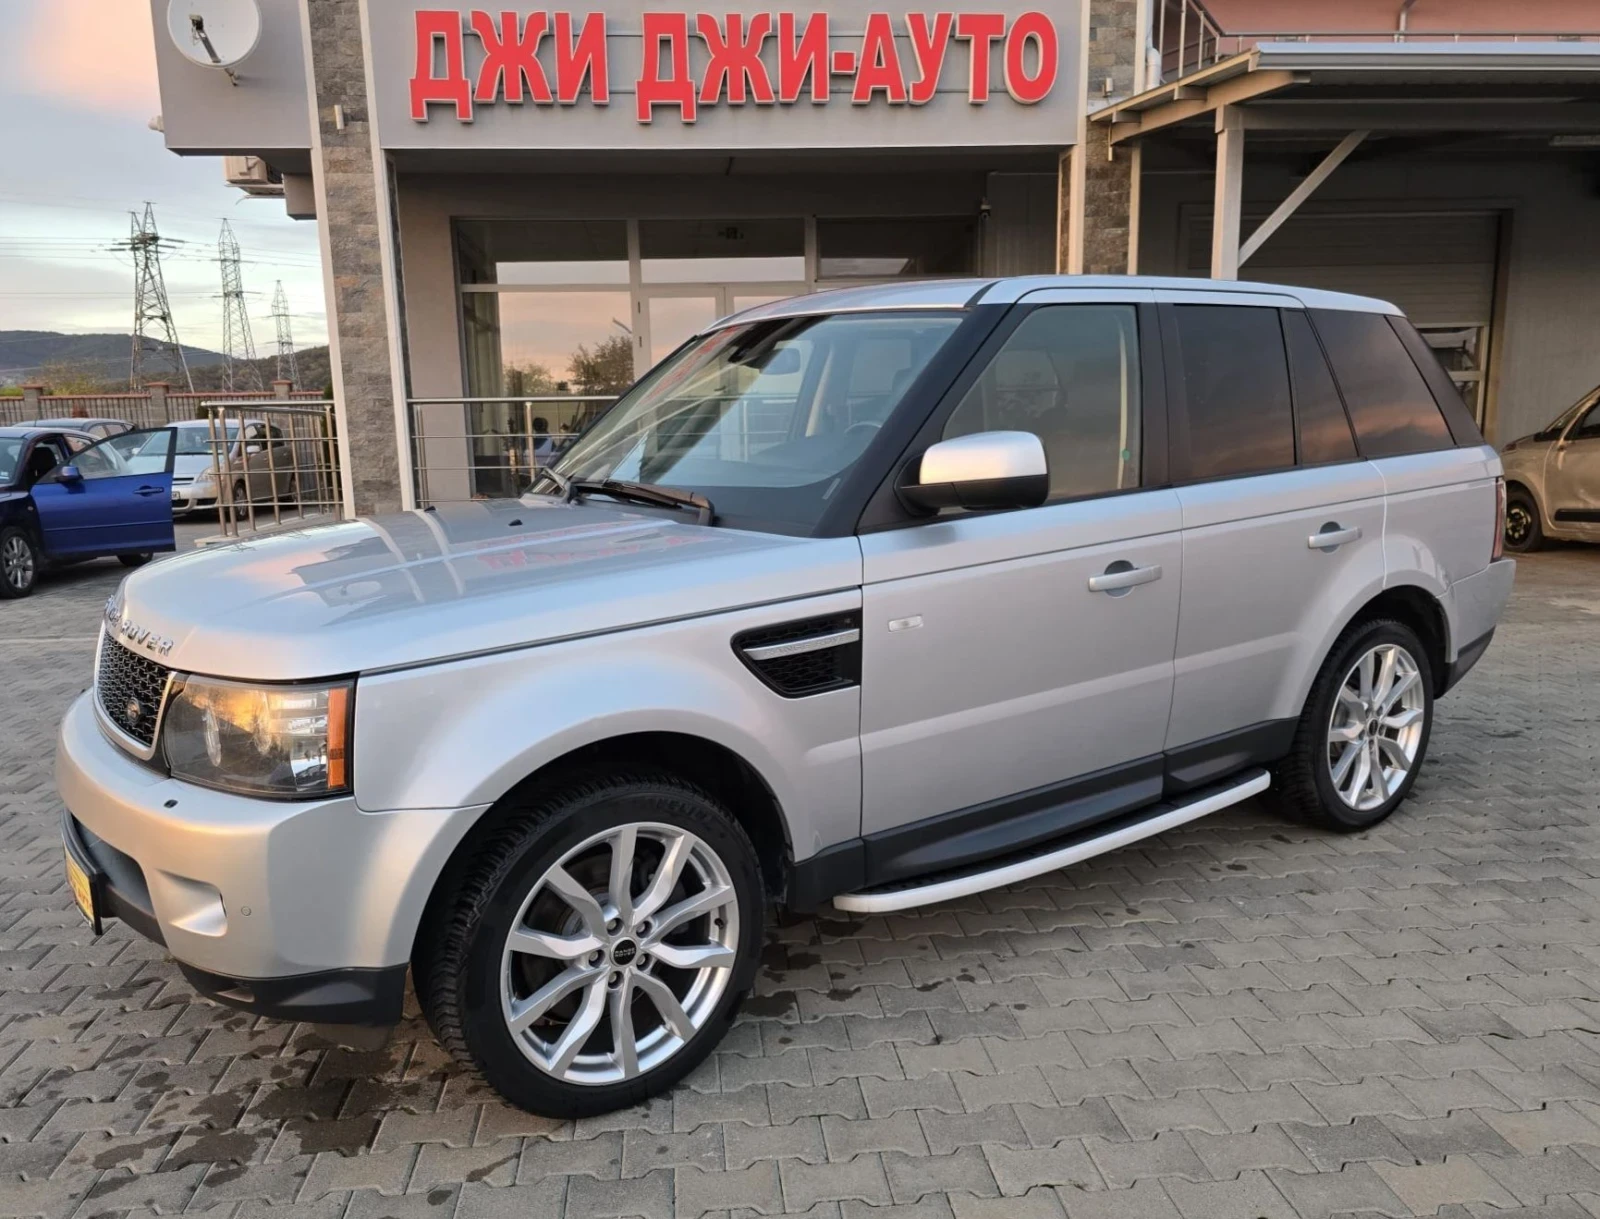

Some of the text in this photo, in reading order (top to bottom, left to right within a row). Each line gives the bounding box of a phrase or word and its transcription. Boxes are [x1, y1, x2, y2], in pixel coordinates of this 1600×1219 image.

[409, 10, 1059, 122] ДЖИ ДЖИ-АУТО
[120, 619, 174, 656] ROVER
